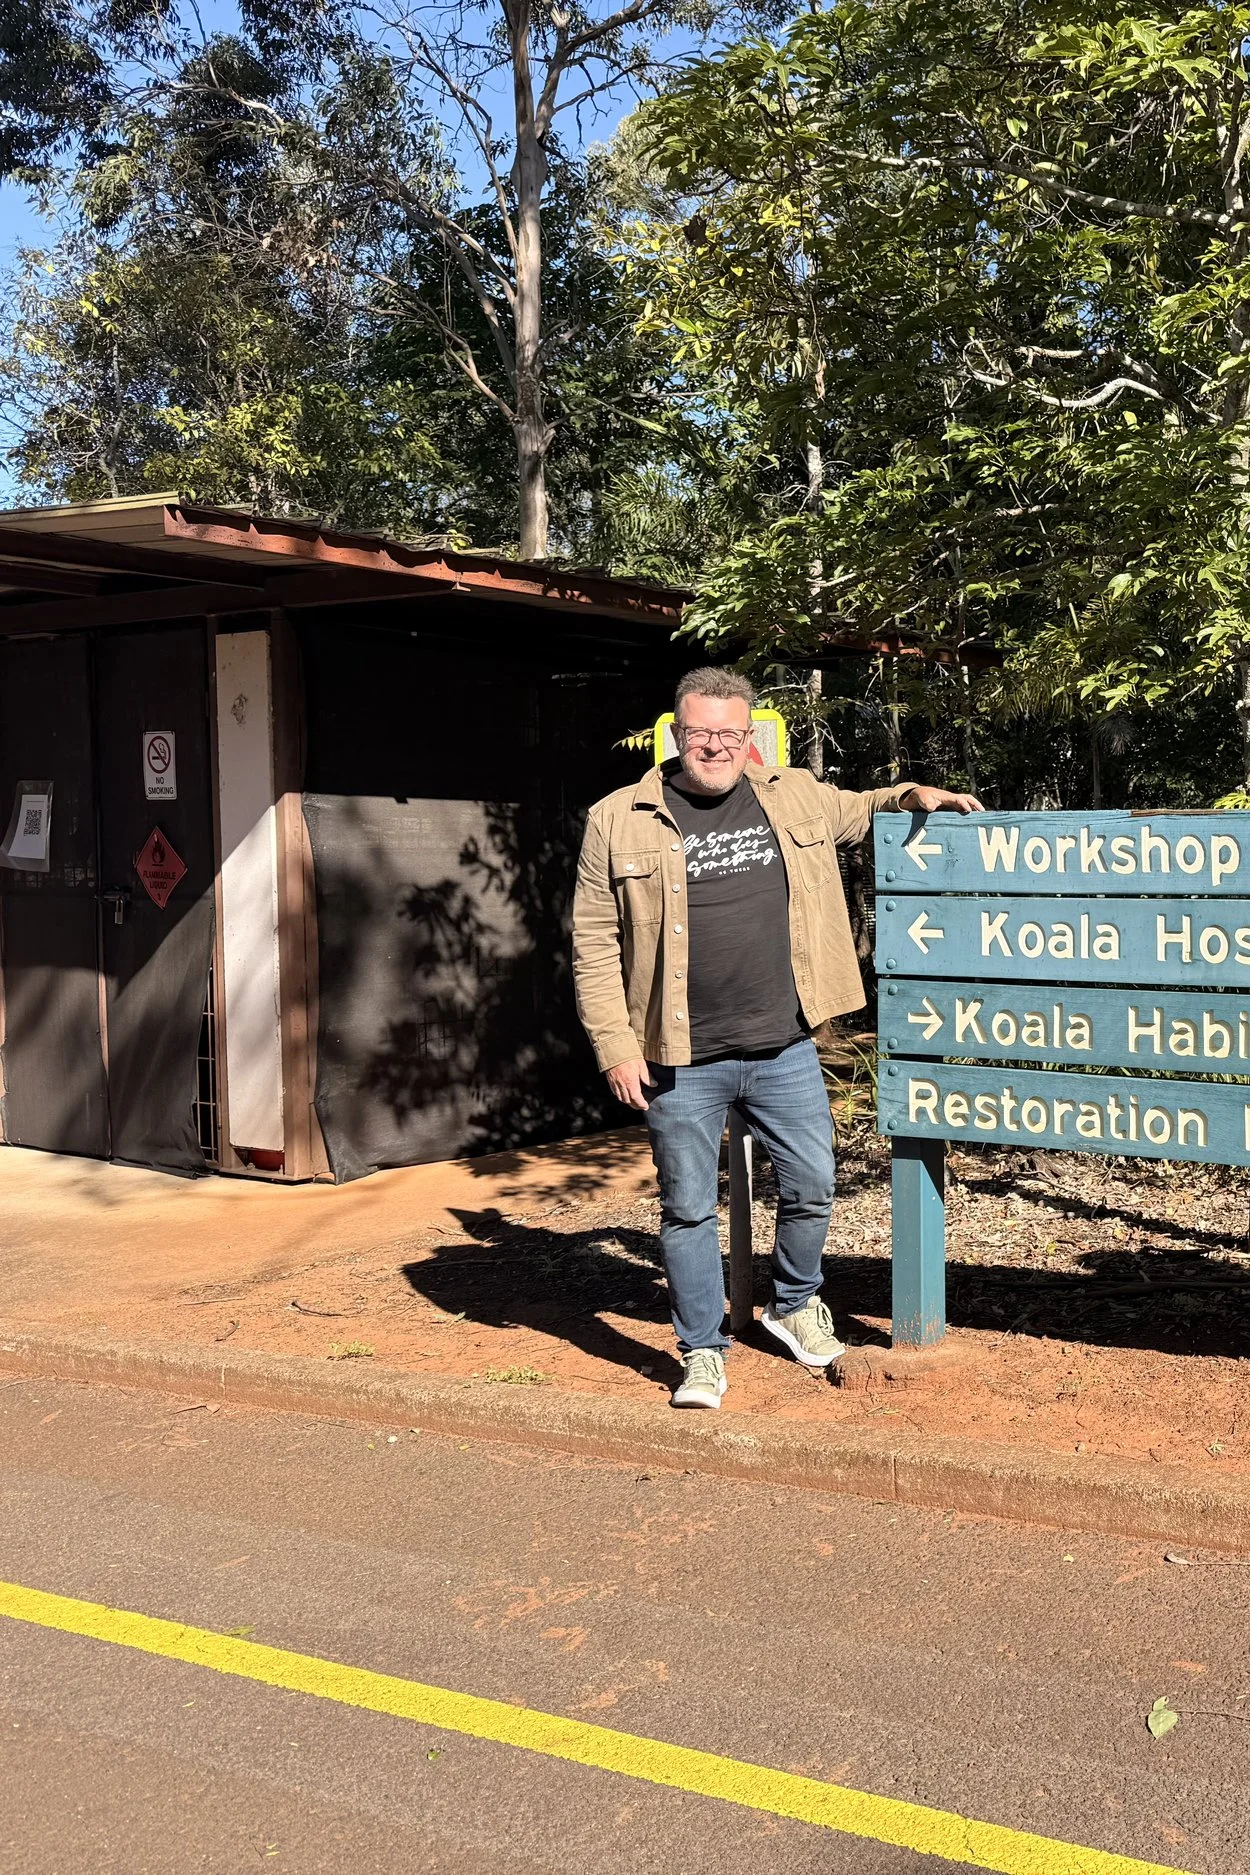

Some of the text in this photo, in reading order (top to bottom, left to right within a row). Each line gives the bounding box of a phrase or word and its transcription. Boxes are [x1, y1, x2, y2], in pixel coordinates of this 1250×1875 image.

[148, 787, 174, 795] SMOKING
[155, 777, 165, 785] NO
[683, 834, 706, 855] Be
[698, 838, 769, 859] who does
[977, 825, 1240, 887] Workshop
[143, 871, 176, 880] FLAMMABLE
[149, 881, 168, 889] LIQUID
[156, 893, 162, 901] 3
[981, 911, 1121, 960] Koala
[955, 997, 1093, 1050] Koala
[908, 1077, 1208, 1147] Restoration
